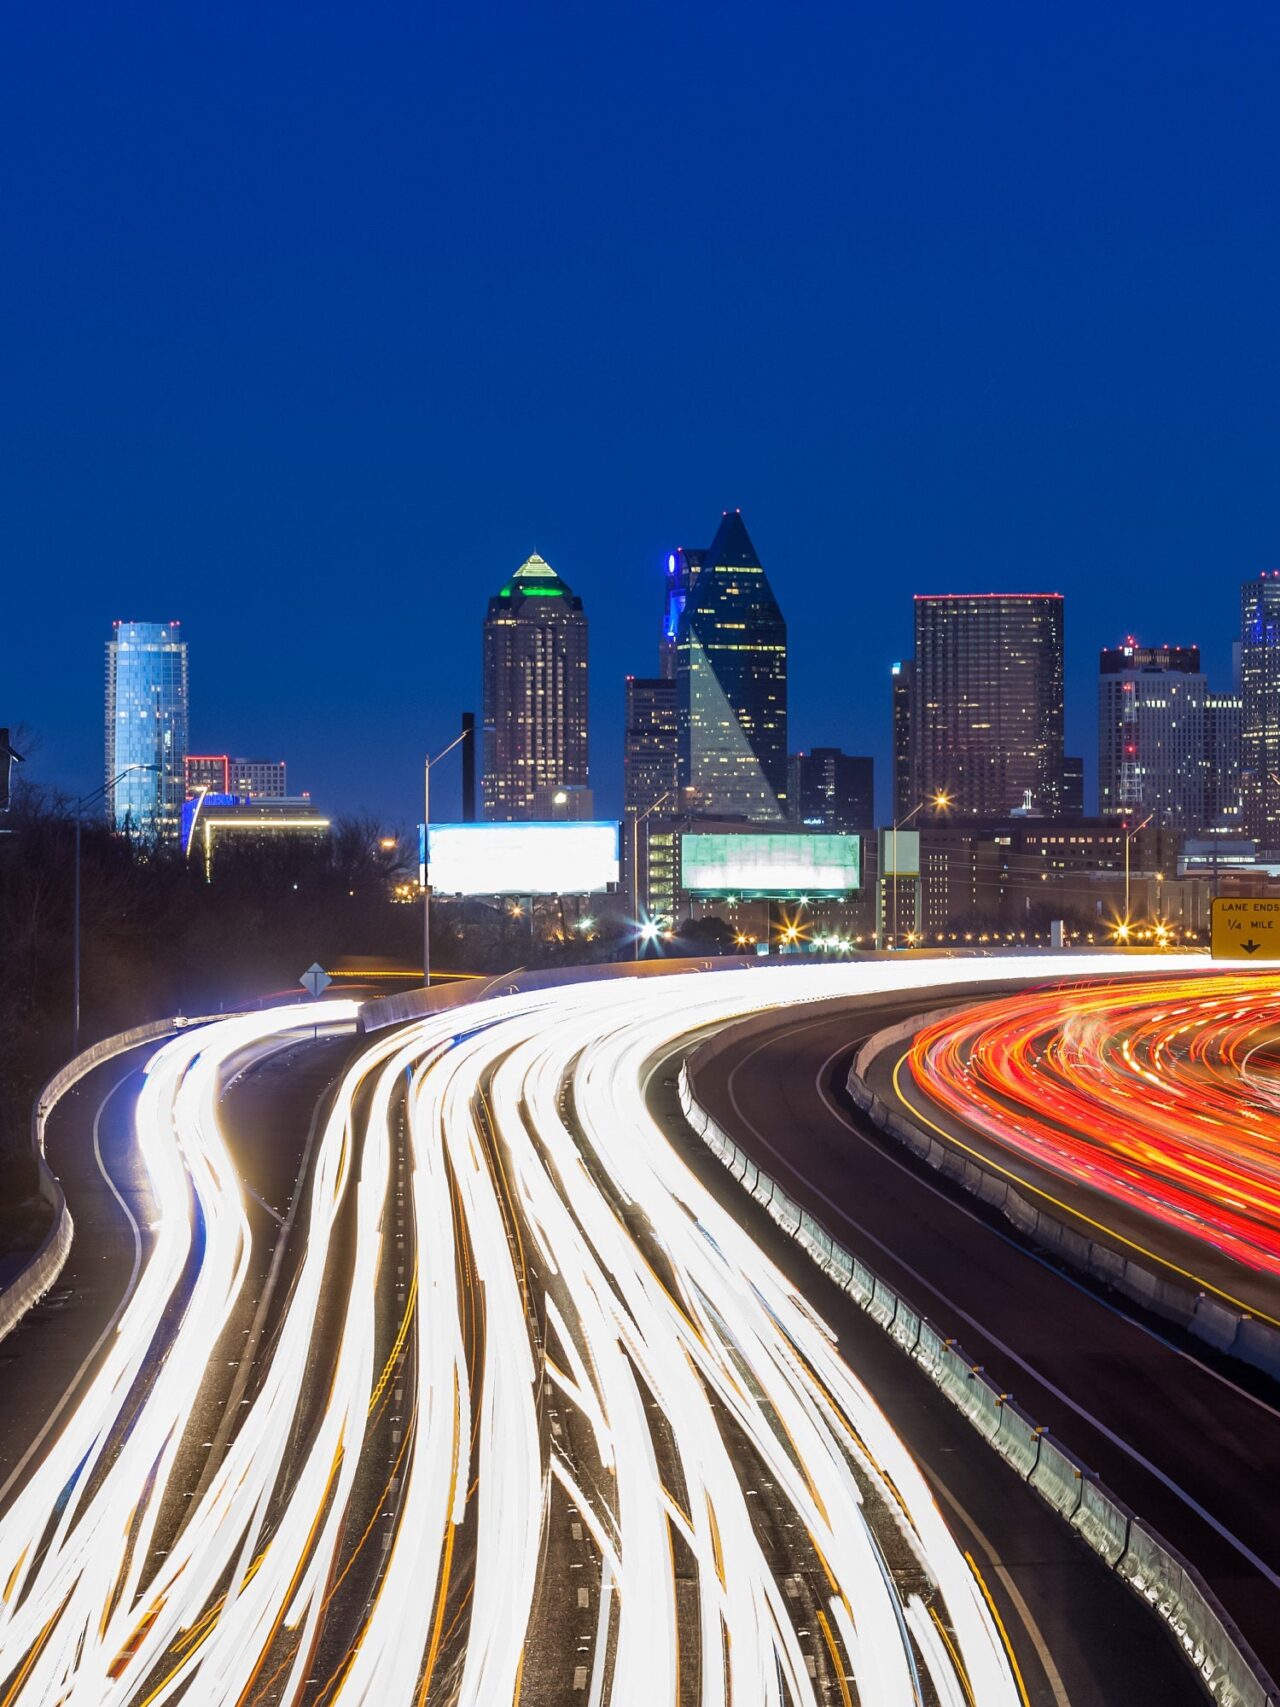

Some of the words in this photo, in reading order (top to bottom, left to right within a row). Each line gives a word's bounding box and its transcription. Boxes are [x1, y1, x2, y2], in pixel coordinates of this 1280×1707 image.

[1221, 903, 1248, 912] LANE
[1253, 903, 1280, 912] ENDS
[1250, 920, 1274, 929] MILE
